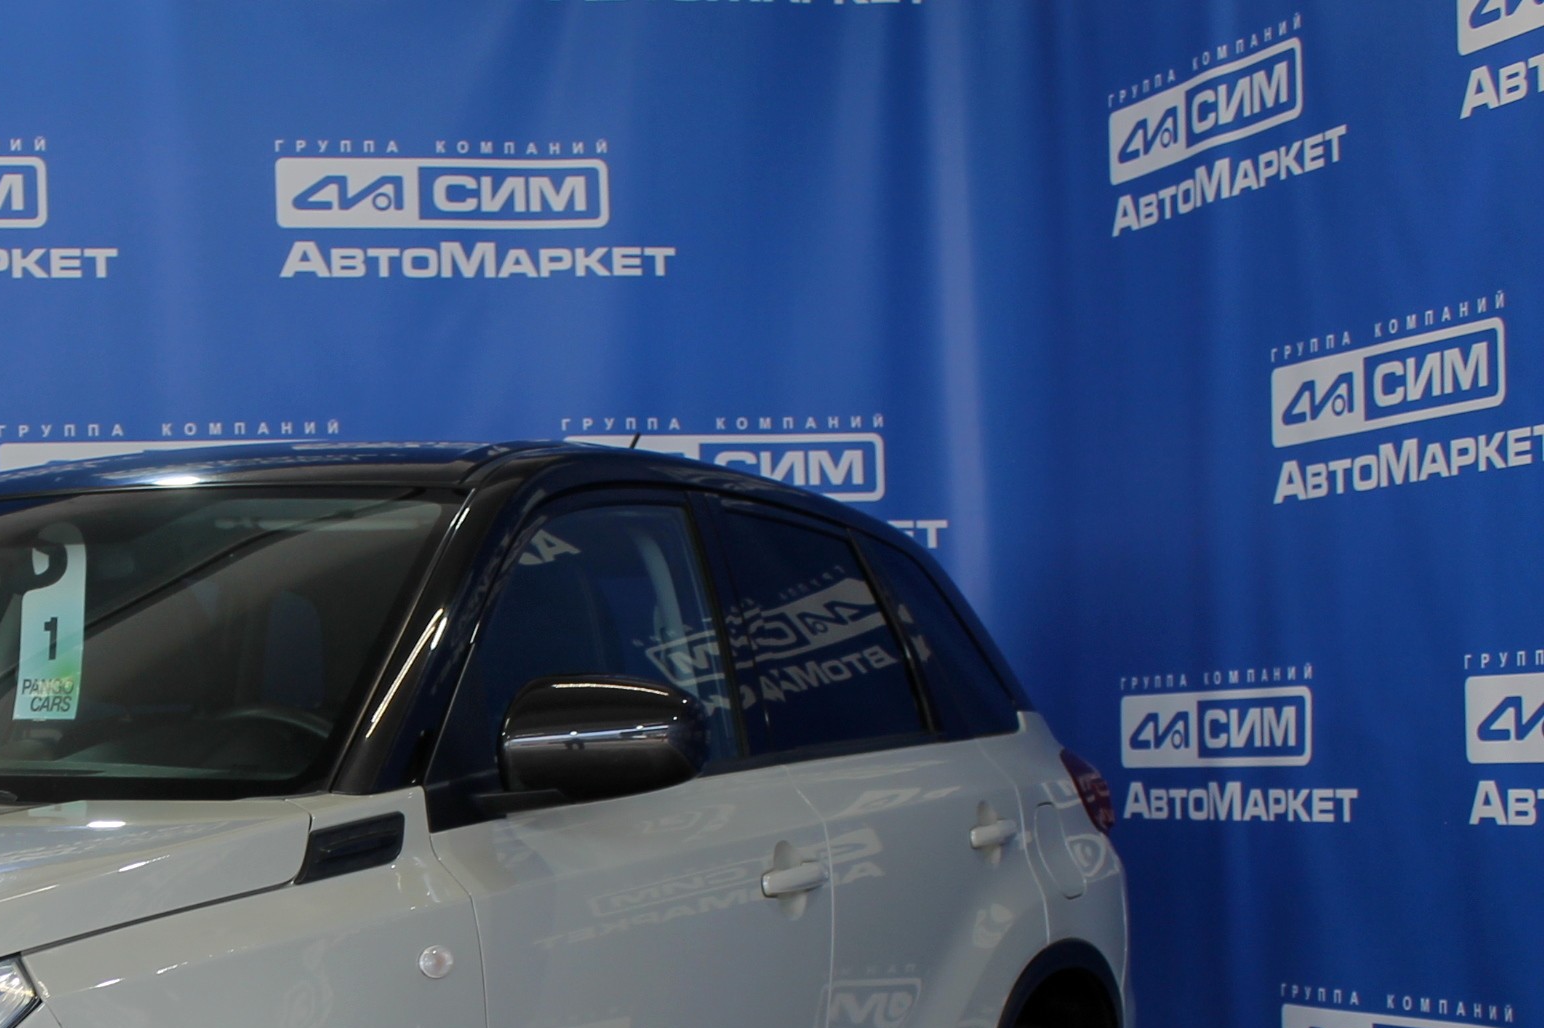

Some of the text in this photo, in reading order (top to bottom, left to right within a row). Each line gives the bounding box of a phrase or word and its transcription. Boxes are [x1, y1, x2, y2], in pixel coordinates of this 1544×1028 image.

[1107, 11, 1303, 109] ГРУППА КОМПАНИЙ
[1192, 60, 1288, 134] СИМ
[274, 138, 608, 155] ГРУППА КОМПАНИЙ
[434, 175, 587, 211] СИМ
[1271, 289, 1507, 362] ГРУППА КОМПАНИЙ
[1373, 342, 1489, 407] СИМ
[161, 419, 339, 436] КОМПАНИЙ
[560, 413, 884, 432] ГРУППА КОМПАНИЙ
[44, 617, 58, 660] 1
[1120, 662, 1313, 690] ГРУППА КОМПАНИЙ
[1464, 649, 1544, 670] ГРУПП
[30, 696, 72, 712] CARS
[1205, 706, 1296, 748] СИМ
[1281, 983, 1513, 1023] ГРУППА КОМПАНИЙ
